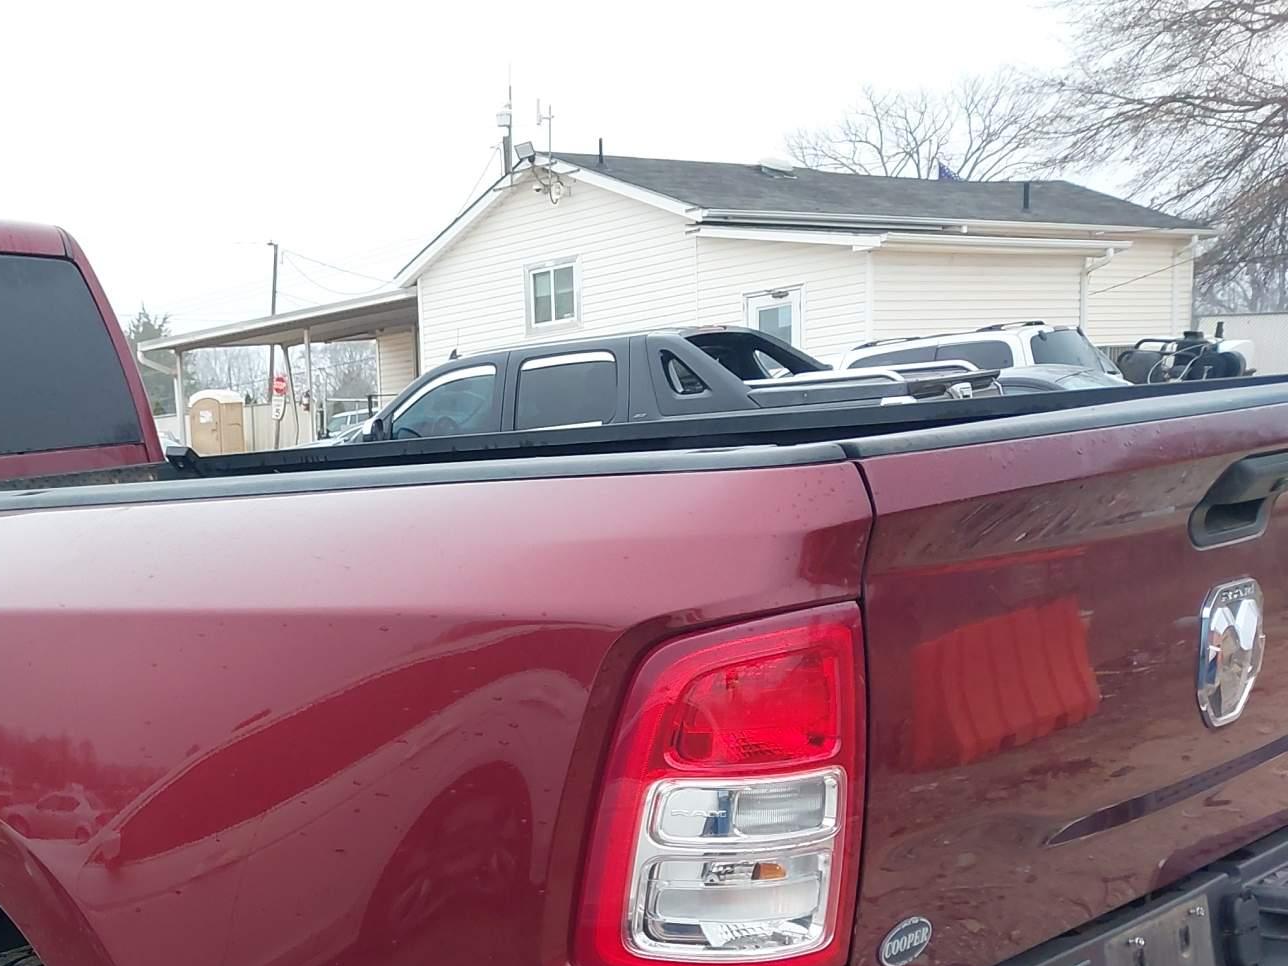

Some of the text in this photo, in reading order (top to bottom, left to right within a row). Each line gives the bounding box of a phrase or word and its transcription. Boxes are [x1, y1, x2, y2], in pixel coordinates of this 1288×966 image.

[1221, 583, 1255, 602] RAM
[671, 809, 727, 818] RAM
[884, 926, 929, 959] COOPER
